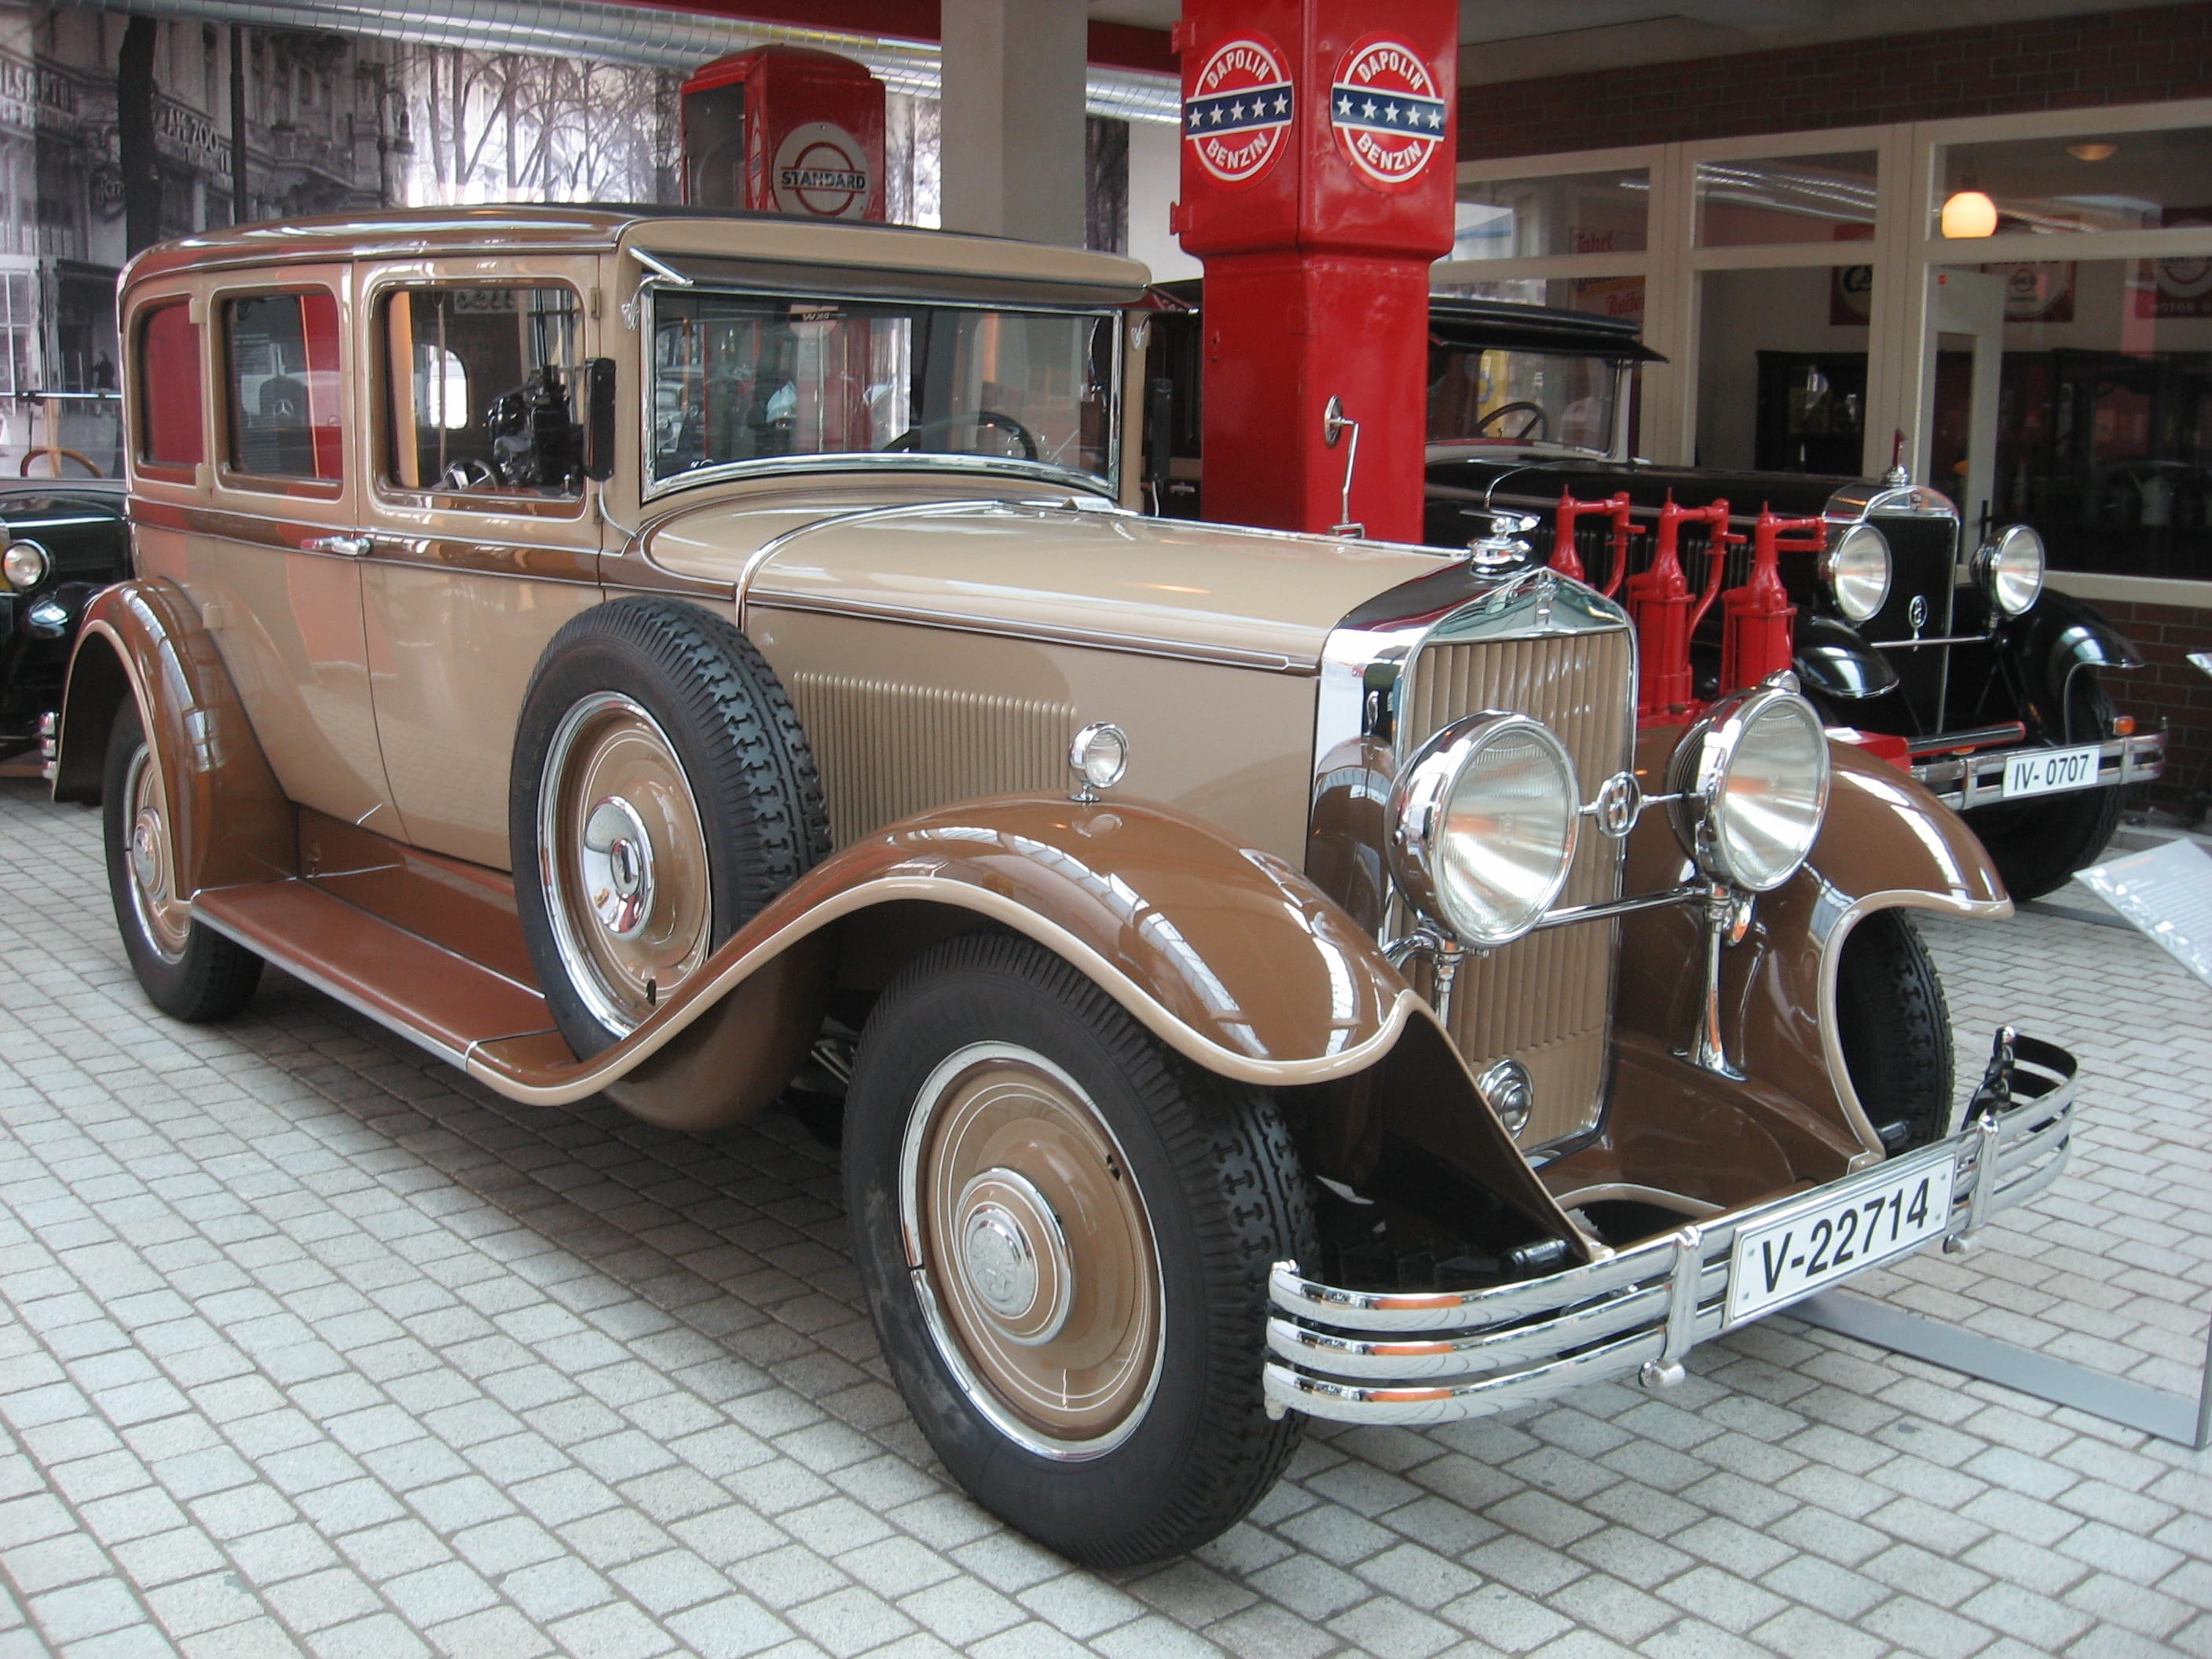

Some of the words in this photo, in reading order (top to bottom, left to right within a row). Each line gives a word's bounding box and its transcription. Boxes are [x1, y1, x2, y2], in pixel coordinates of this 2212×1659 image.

[1206, 49, 1270, 90] DAPOLIN
[1357, 50, 1425, 92] DAPOLIN
[1206, 131, 1269, 170] BENZIN
[1357, 131, 1423, 171] BENZIN
[781, 170, 866, 189] STANDARD
[1763, 1177, 1929, 1293] V-22714
